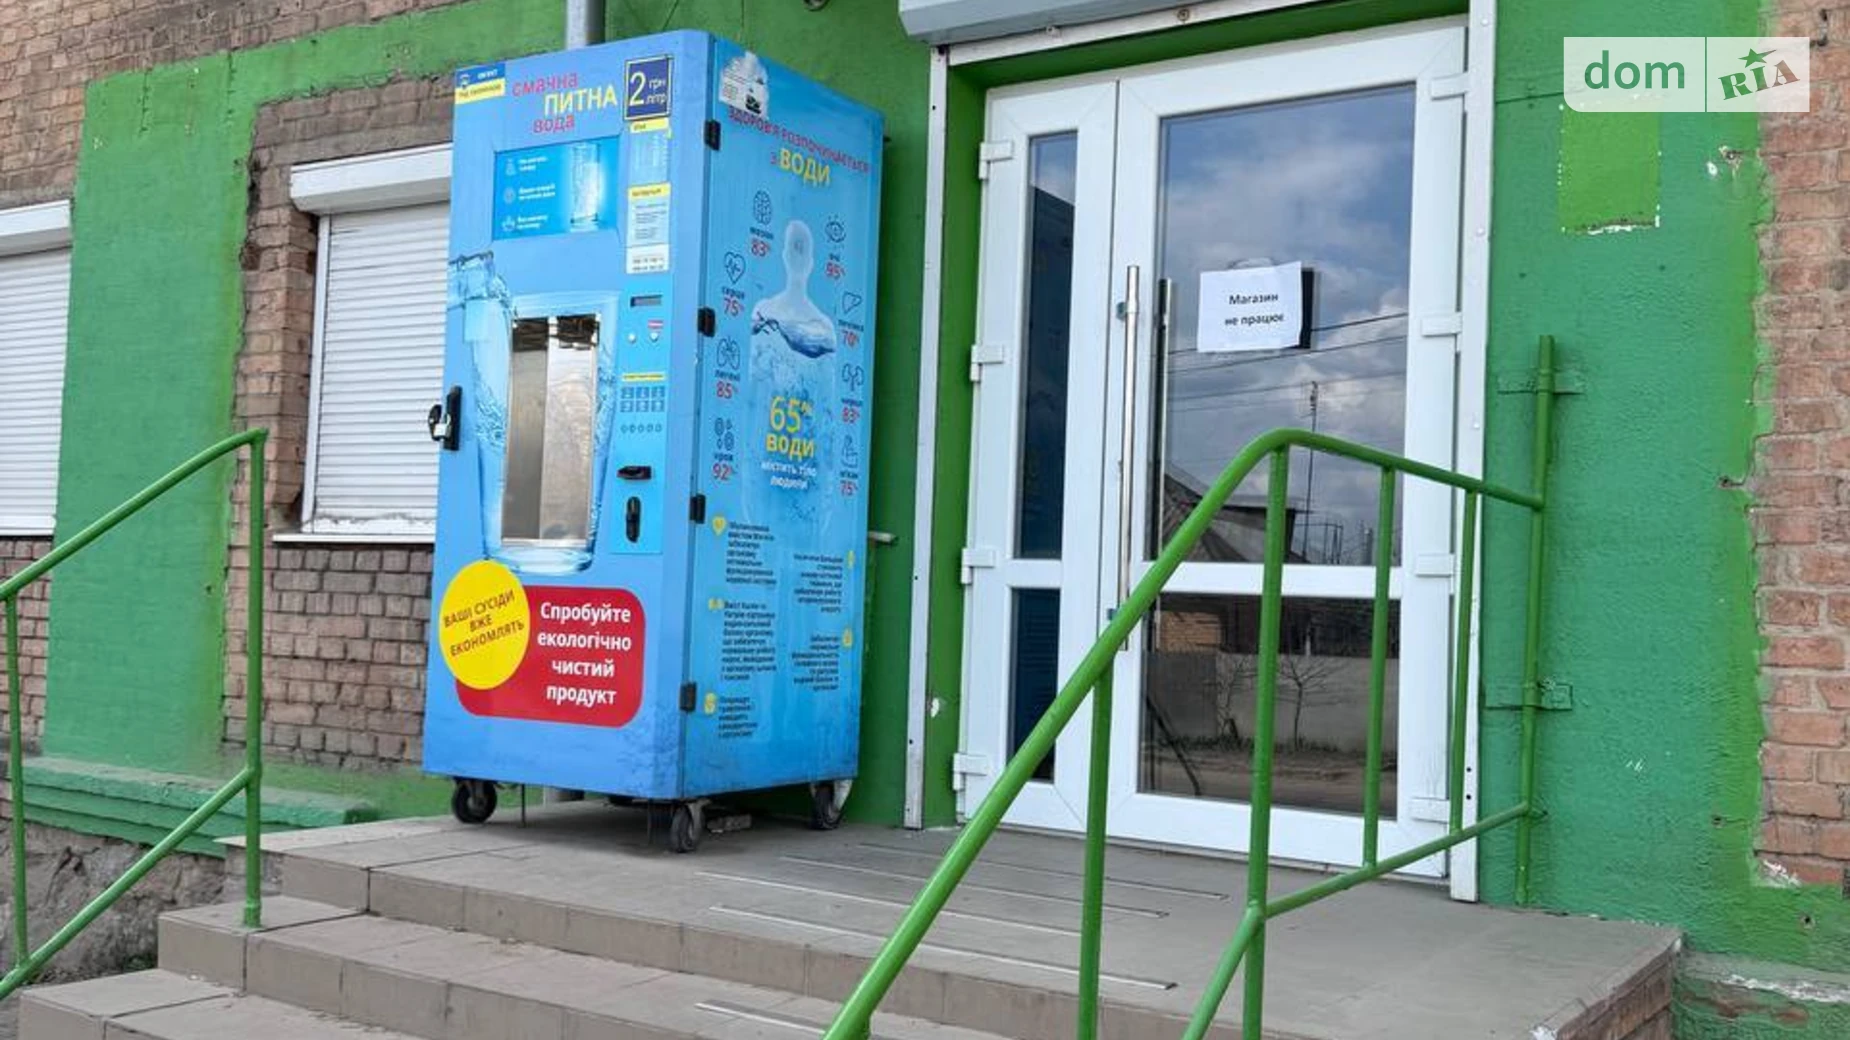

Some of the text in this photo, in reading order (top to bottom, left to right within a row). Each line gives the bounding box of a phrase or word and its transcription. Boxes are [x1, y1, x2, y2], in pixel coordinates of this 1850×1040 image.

[512, 72, 578, 97] смачна
[629, 71, 646, 106] 2
[648, 79, 666, 91] грн
[544, 84, 618, 118] ПИТНА
[645, 93, 668, 105] літр
[533, 114, 575, 135] вода
[780, 147, 831, 186] ВОДИ
[1229, 293, 1279, 305] Магазин
[1224, 313, 1283, 327] не працює
[443, 589, 515, 629] ВАШІ СУСІДИ
[540, 602, 631, 626] Спробуйте
[469, 614, 493, 633] ВЖЕ
[450, 619, 525, 657] ЕКОНОМЛЯТЬ
[537, 630, 632, 652] екологічно
[551, 658, 616, 678] чистий
[546, 685, 617, 708] продукт
